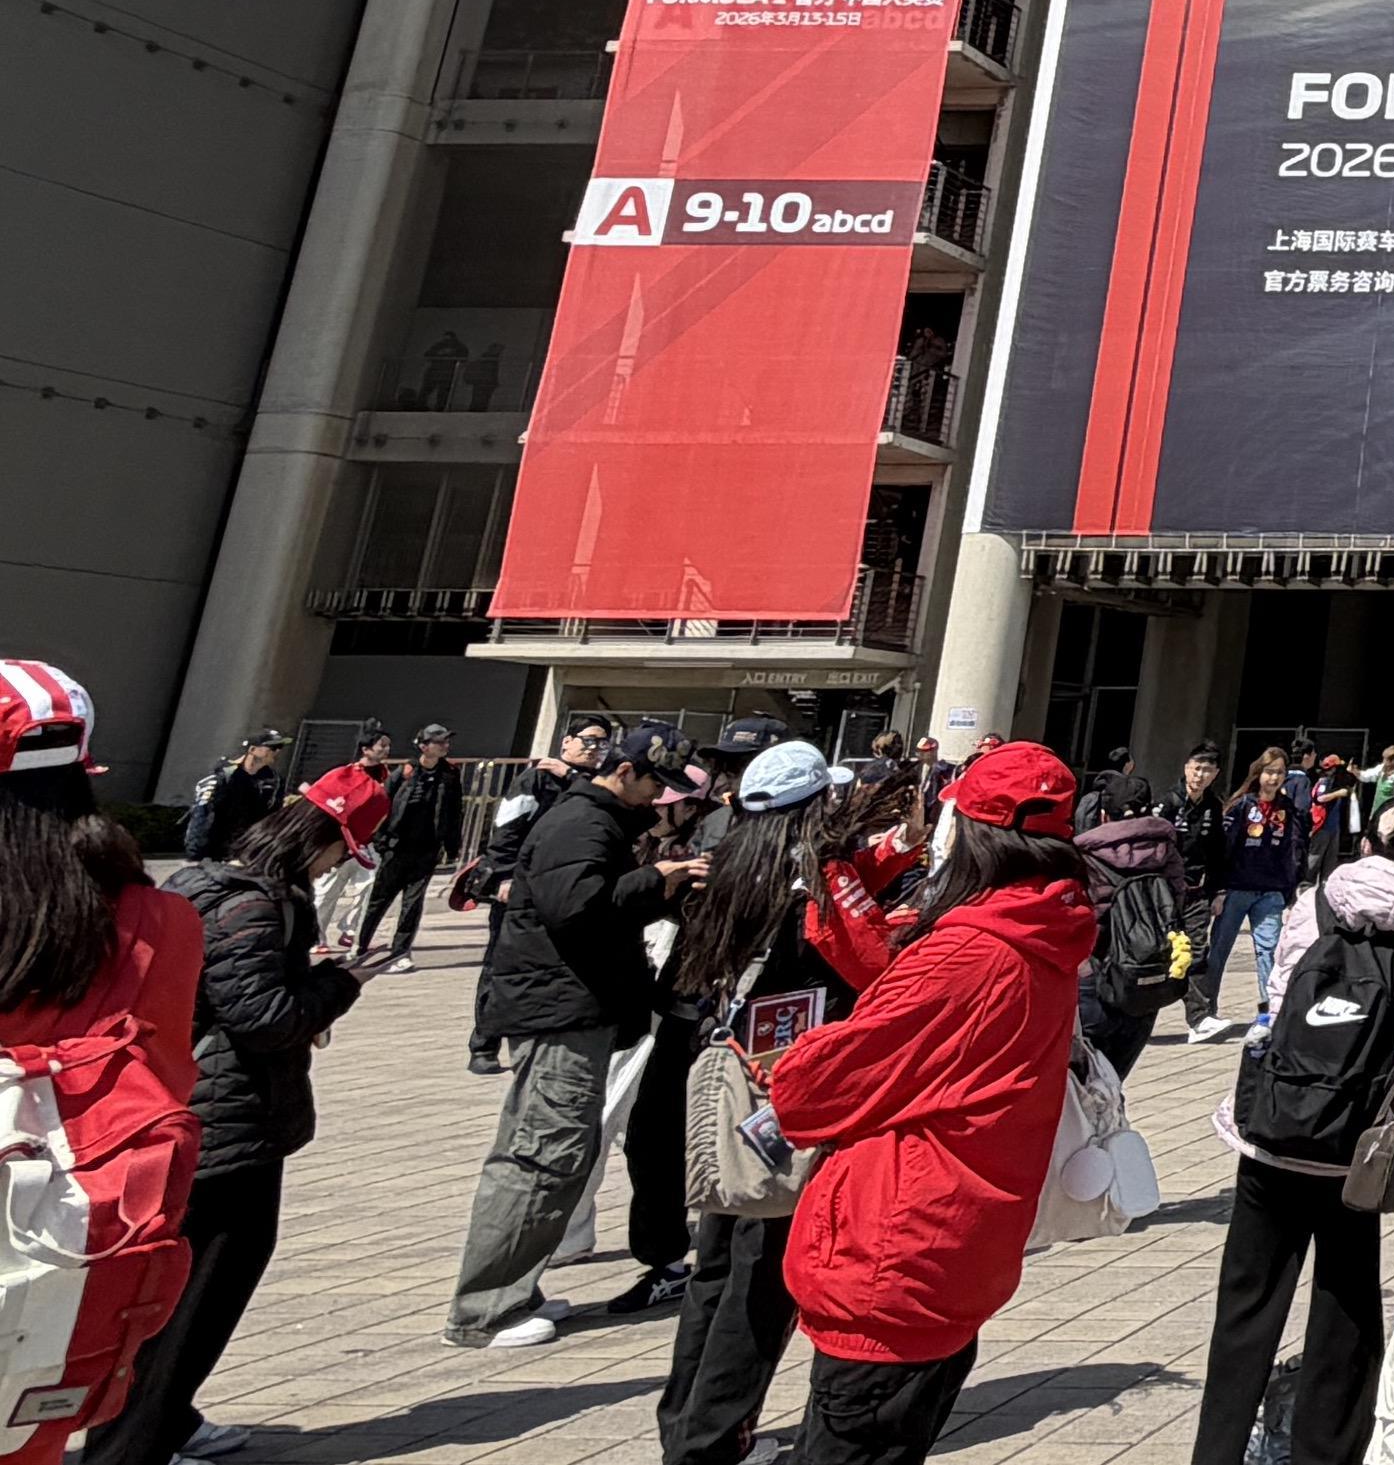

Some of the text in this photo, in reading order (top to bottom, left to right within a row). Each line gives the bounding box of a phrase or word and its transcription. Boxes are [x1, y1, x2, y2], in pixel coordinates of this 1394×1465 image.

[714, 11, 861, 26] 2026年3月13-15日
[594, 185, 652, 237] A
[743, 673, 808, 684] 入口 ENTRY
[853, 673, 880, 684] EXIT
